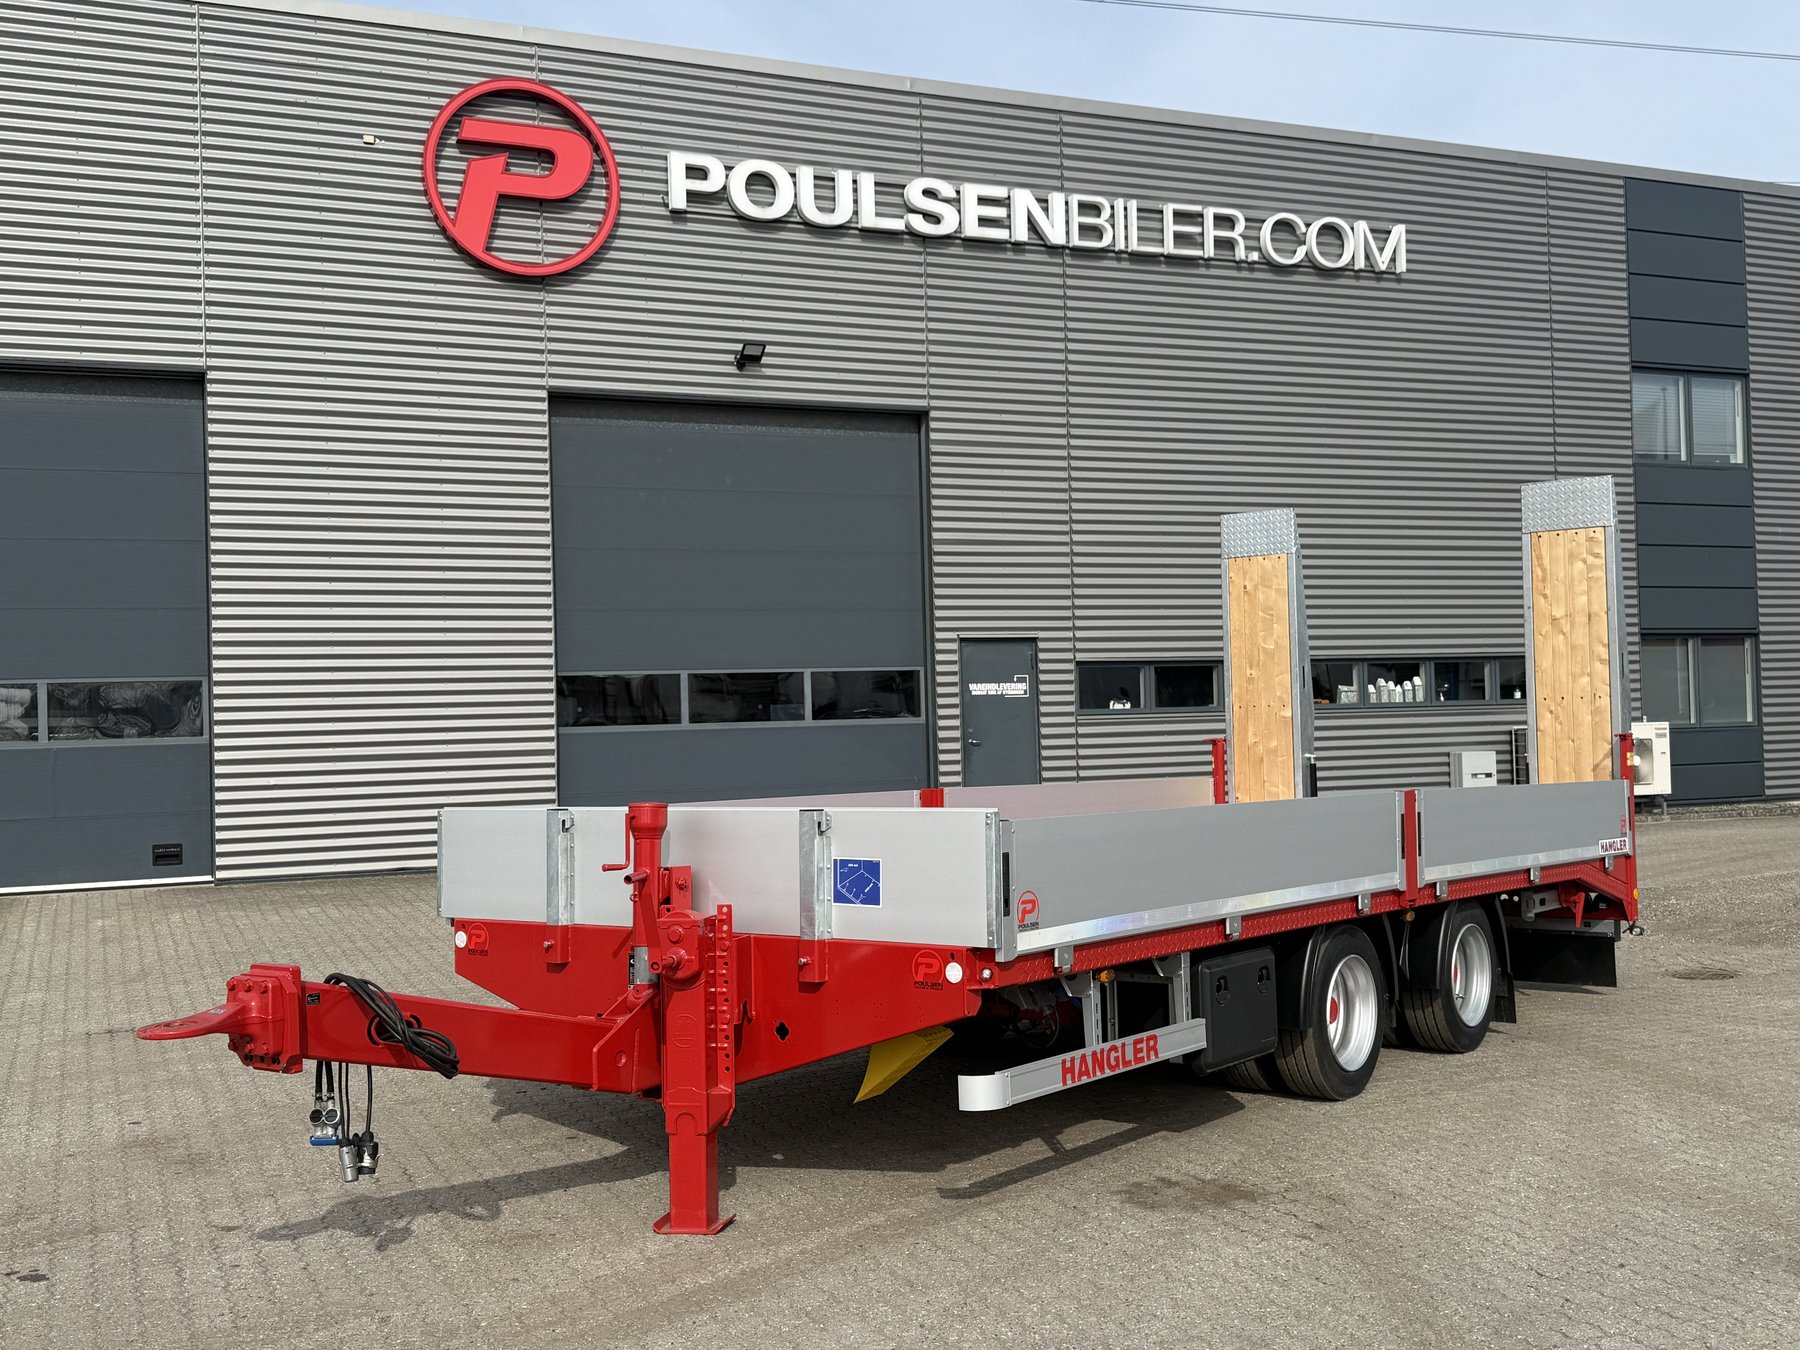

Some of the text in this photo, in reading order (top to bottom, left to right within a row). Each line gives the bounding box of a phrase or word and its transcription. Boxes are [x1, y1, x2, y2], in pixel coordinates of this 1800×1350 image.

[452, 116, 594, 254] P
[666, 151, 1407, 274] POULSENBILER.COM
[1601, 839, 1627, 853] HANGLER
[1018, 921, 1039, 930] POULSEN
[1061, 1034, 1160, 1087] HANGLER
